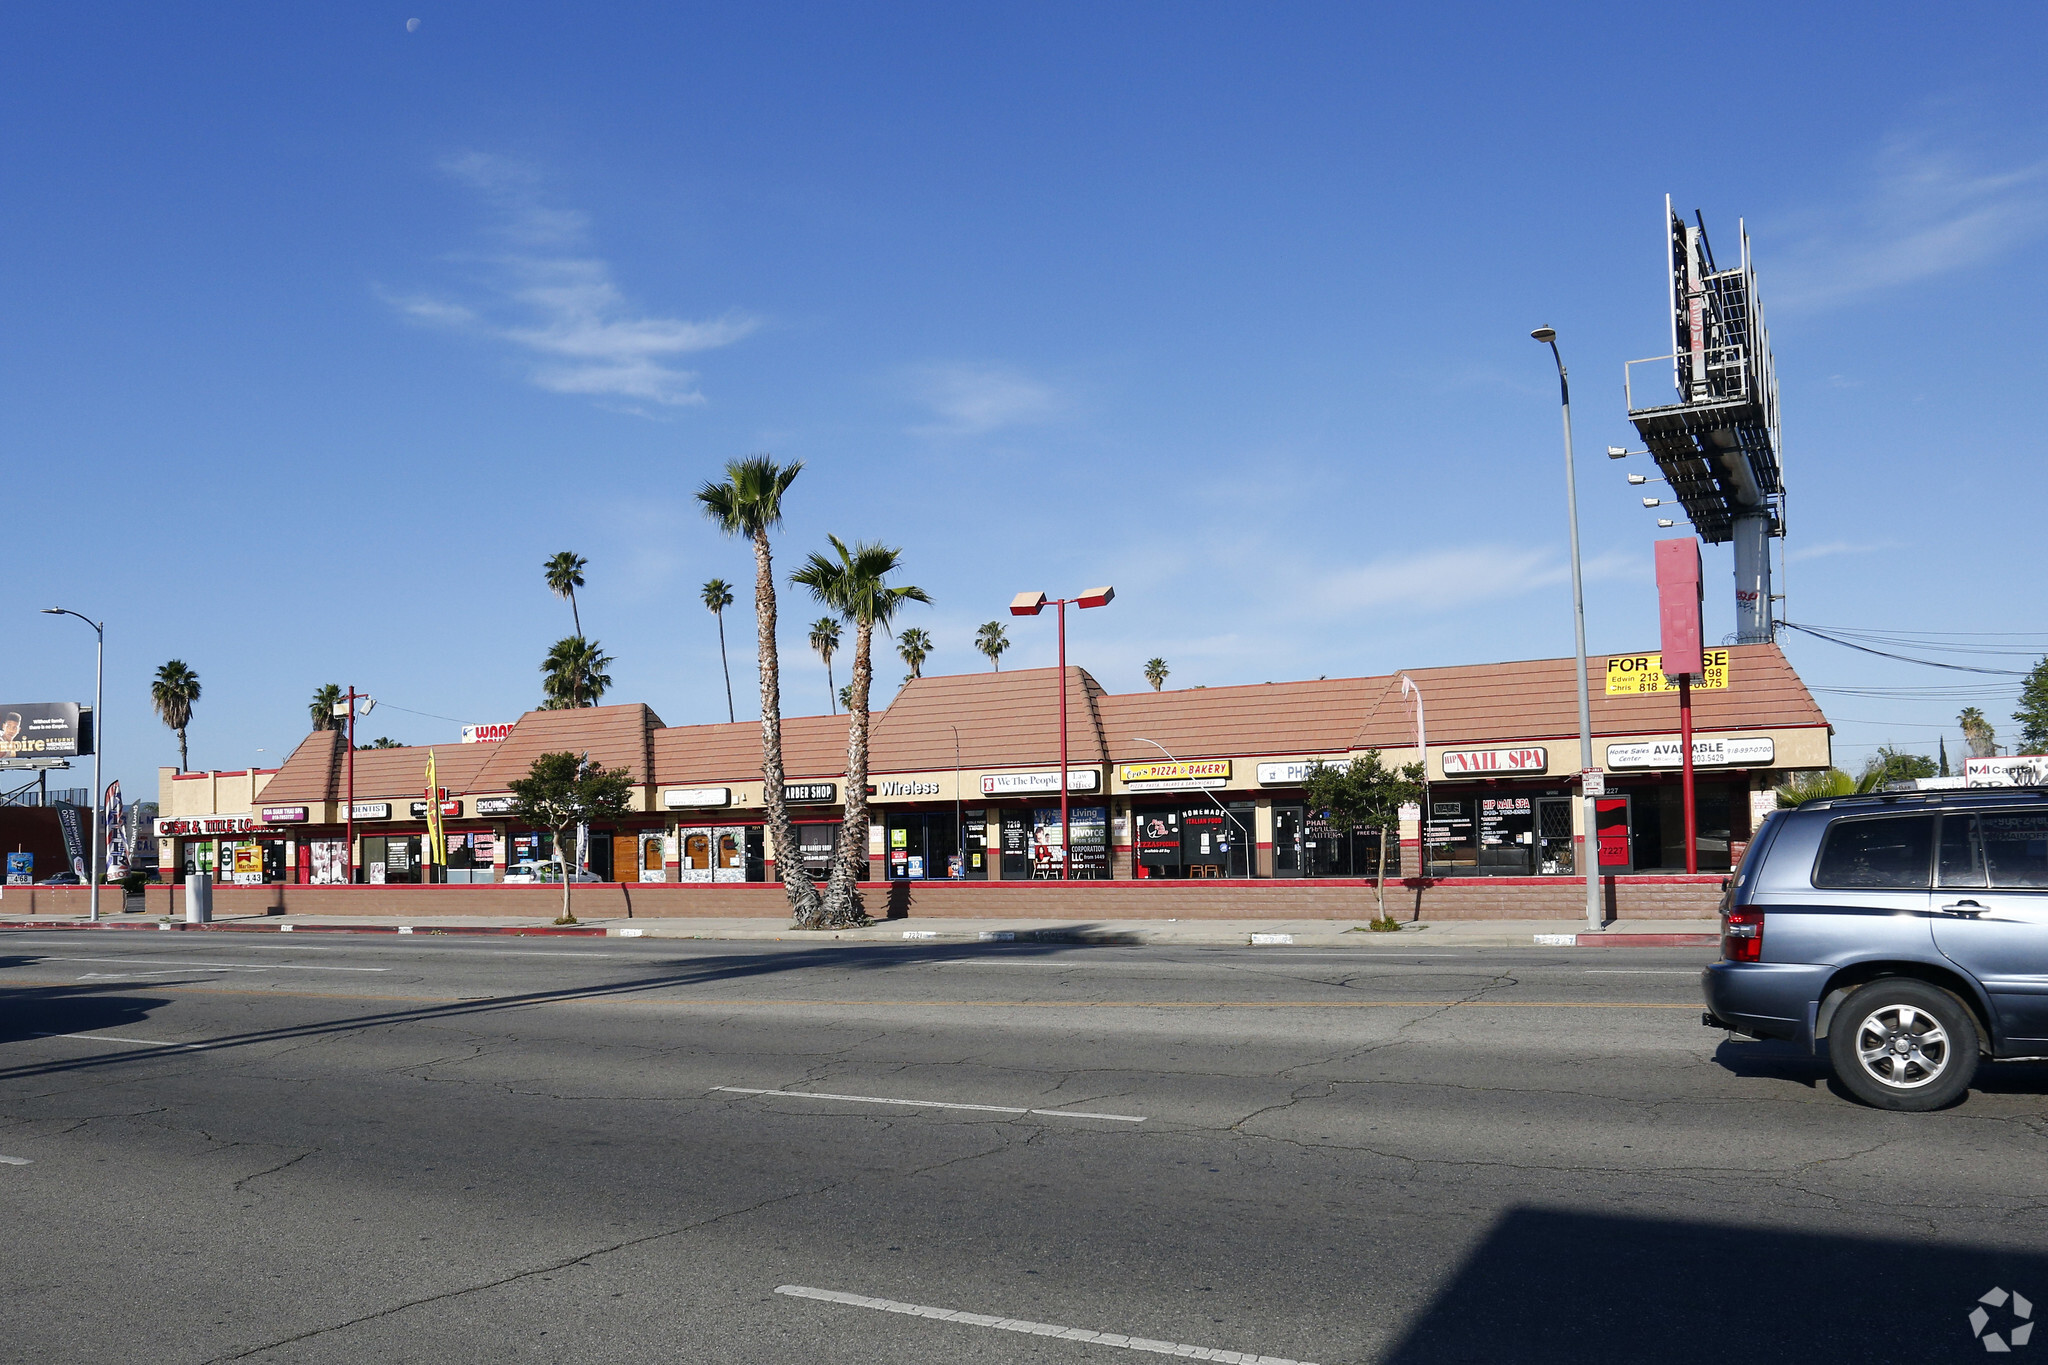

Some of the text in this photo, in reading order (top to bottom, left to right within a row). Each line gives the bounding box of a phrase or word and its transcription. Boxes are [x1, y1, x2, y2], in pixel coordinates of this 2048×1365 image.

[1608, 657, 1648, 673] FOR
[1640, 673, 1659, 682] 213
[1639, 682, 1658, 692] 818
[1653, 742, 1724, 755] AVAIABLE
[1444, 749, 1543, 771] HIP NAIL SPA
[1151, 766, 1177, 776] PIZZA
[1188, 763, 1227, 775] BAKERY
[1992, 764, 2036, 775] Capital
[1072, 772, 1087, 780] Law
[996, 775, 1059, 787] We The People
[1068, 781, 1093, 789] Office
[785, 785, 831, 799] ARBER SHOP
[880, 781, 939, 796] Wireless
[413, 803, 427, 811] Sho
[1482, 798, 1531, 810] HIP NAIL SPA
[352, 805, 385, 813] DENTIST
[1072, 809, 1098, 818] Living
[1182, 809, 1225, 818] HOMEMADE
[1071, 817, 1093, 825] Trust
[160, 820, 190, 834] CASH
[191, 820, 201, 834] &
[204, 818, 235, 833] TITLE
[1071, 828, 1105, 837] Divorce
[1603, 847, 1624, 855] 7227
[1071, 853, 1084, 861] LLC
